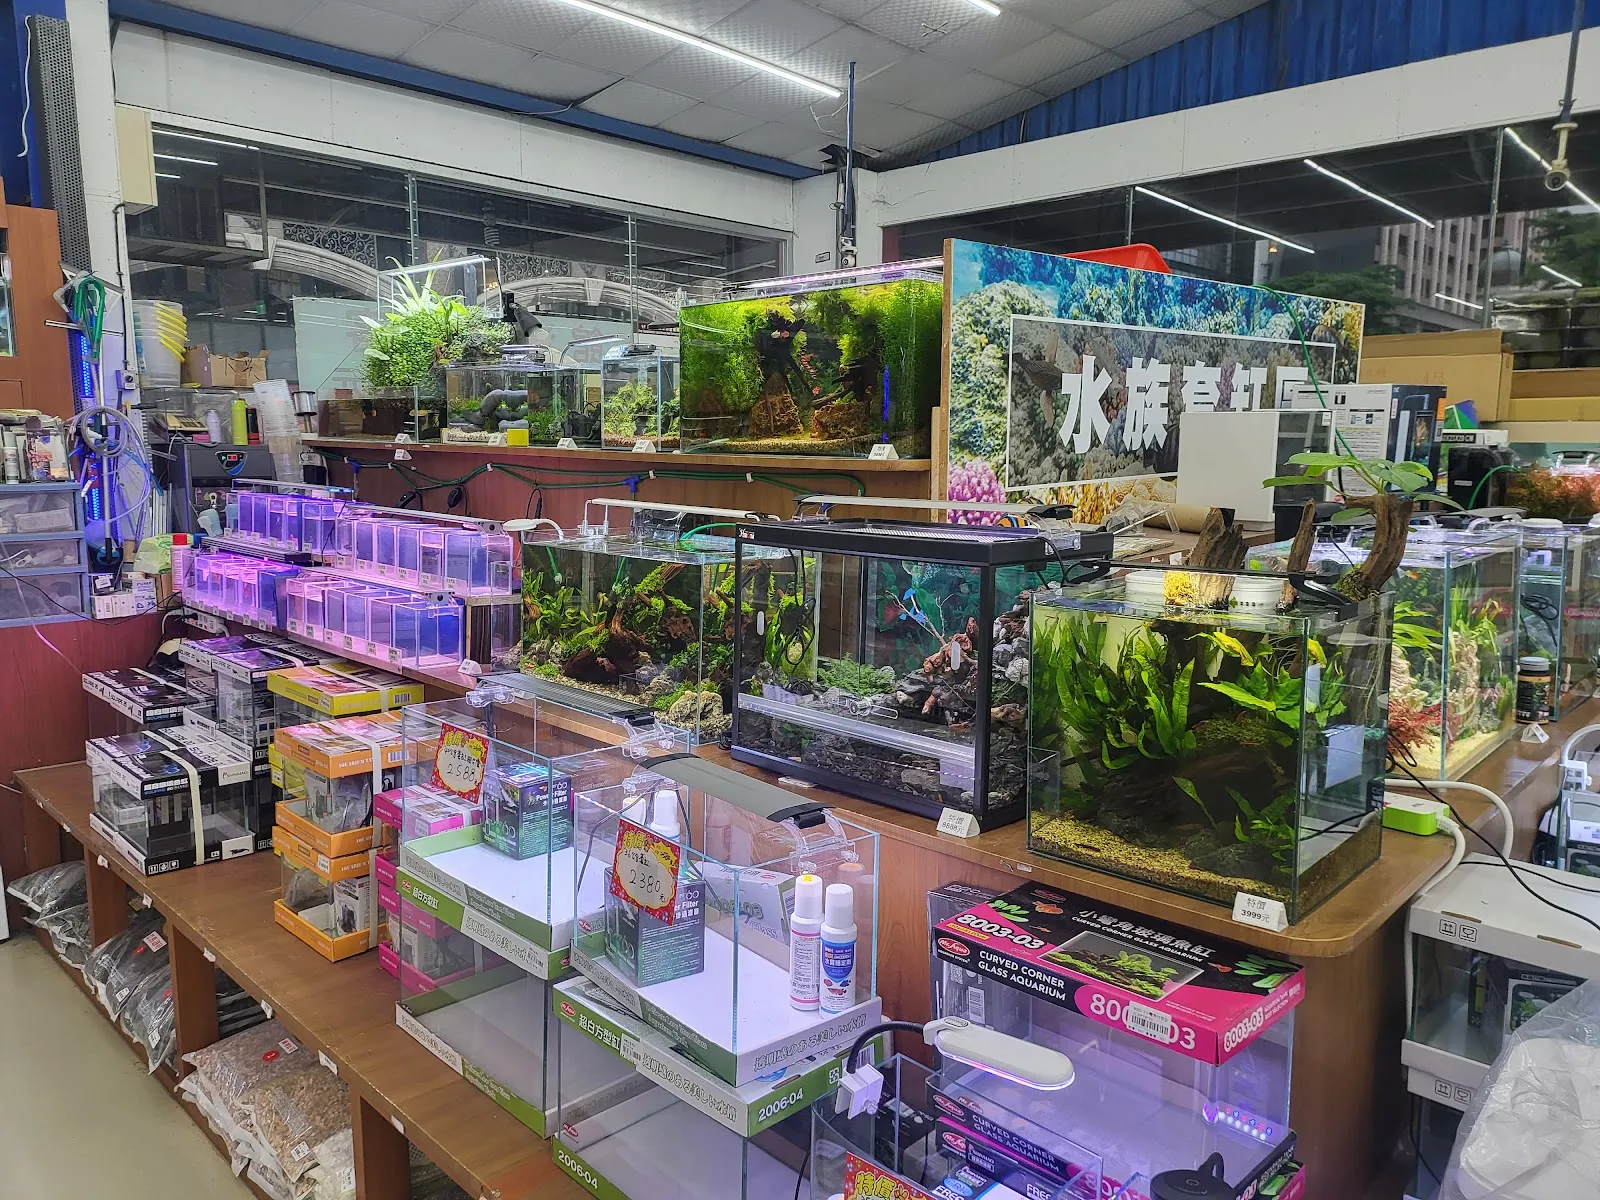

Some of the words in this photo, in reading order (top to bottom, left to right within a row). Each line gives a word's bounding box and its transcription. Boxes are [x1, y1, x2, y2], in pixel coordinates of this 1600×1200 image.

[682, 900, 699, 911] Filter
[1241, 909, 1271, 924] 3999元
[1247, 897, 1267, 911] 特價
[956, 914, 1046, 950] 8003-03
[1071, 916, 1101, 929] CURVED
[1101, 926, 1133, 939] CORNER
[1133, 936, 1159, 949] GLASS
[1159, 945, 1204, 962] AQUARIUM
[978, 961, 1008, 979] GLASS
[1009, 973, 1067, 1002] AQUARIUM
[979, 950, 1019, 972] CURVED
[1020, 966, 1065, 989] CORNER
[579, 1013, 621, 1051] 超白方型缸
[1223, 1006, 1265, 1053] 8003-03
[758, 1087, 804, 1123] 2006-04
[972, 1114, 1011, 1139] CURVED
[1012, 1135, 1056, 1164] CORNER
[973, 1122, 1004, 1143] GLASS
[1005, 1141, 1060, 1173] AQUARIUM
[558, 1149, 599, 1190] 2006-04
[856, 1171, 897, 1200] 特價
